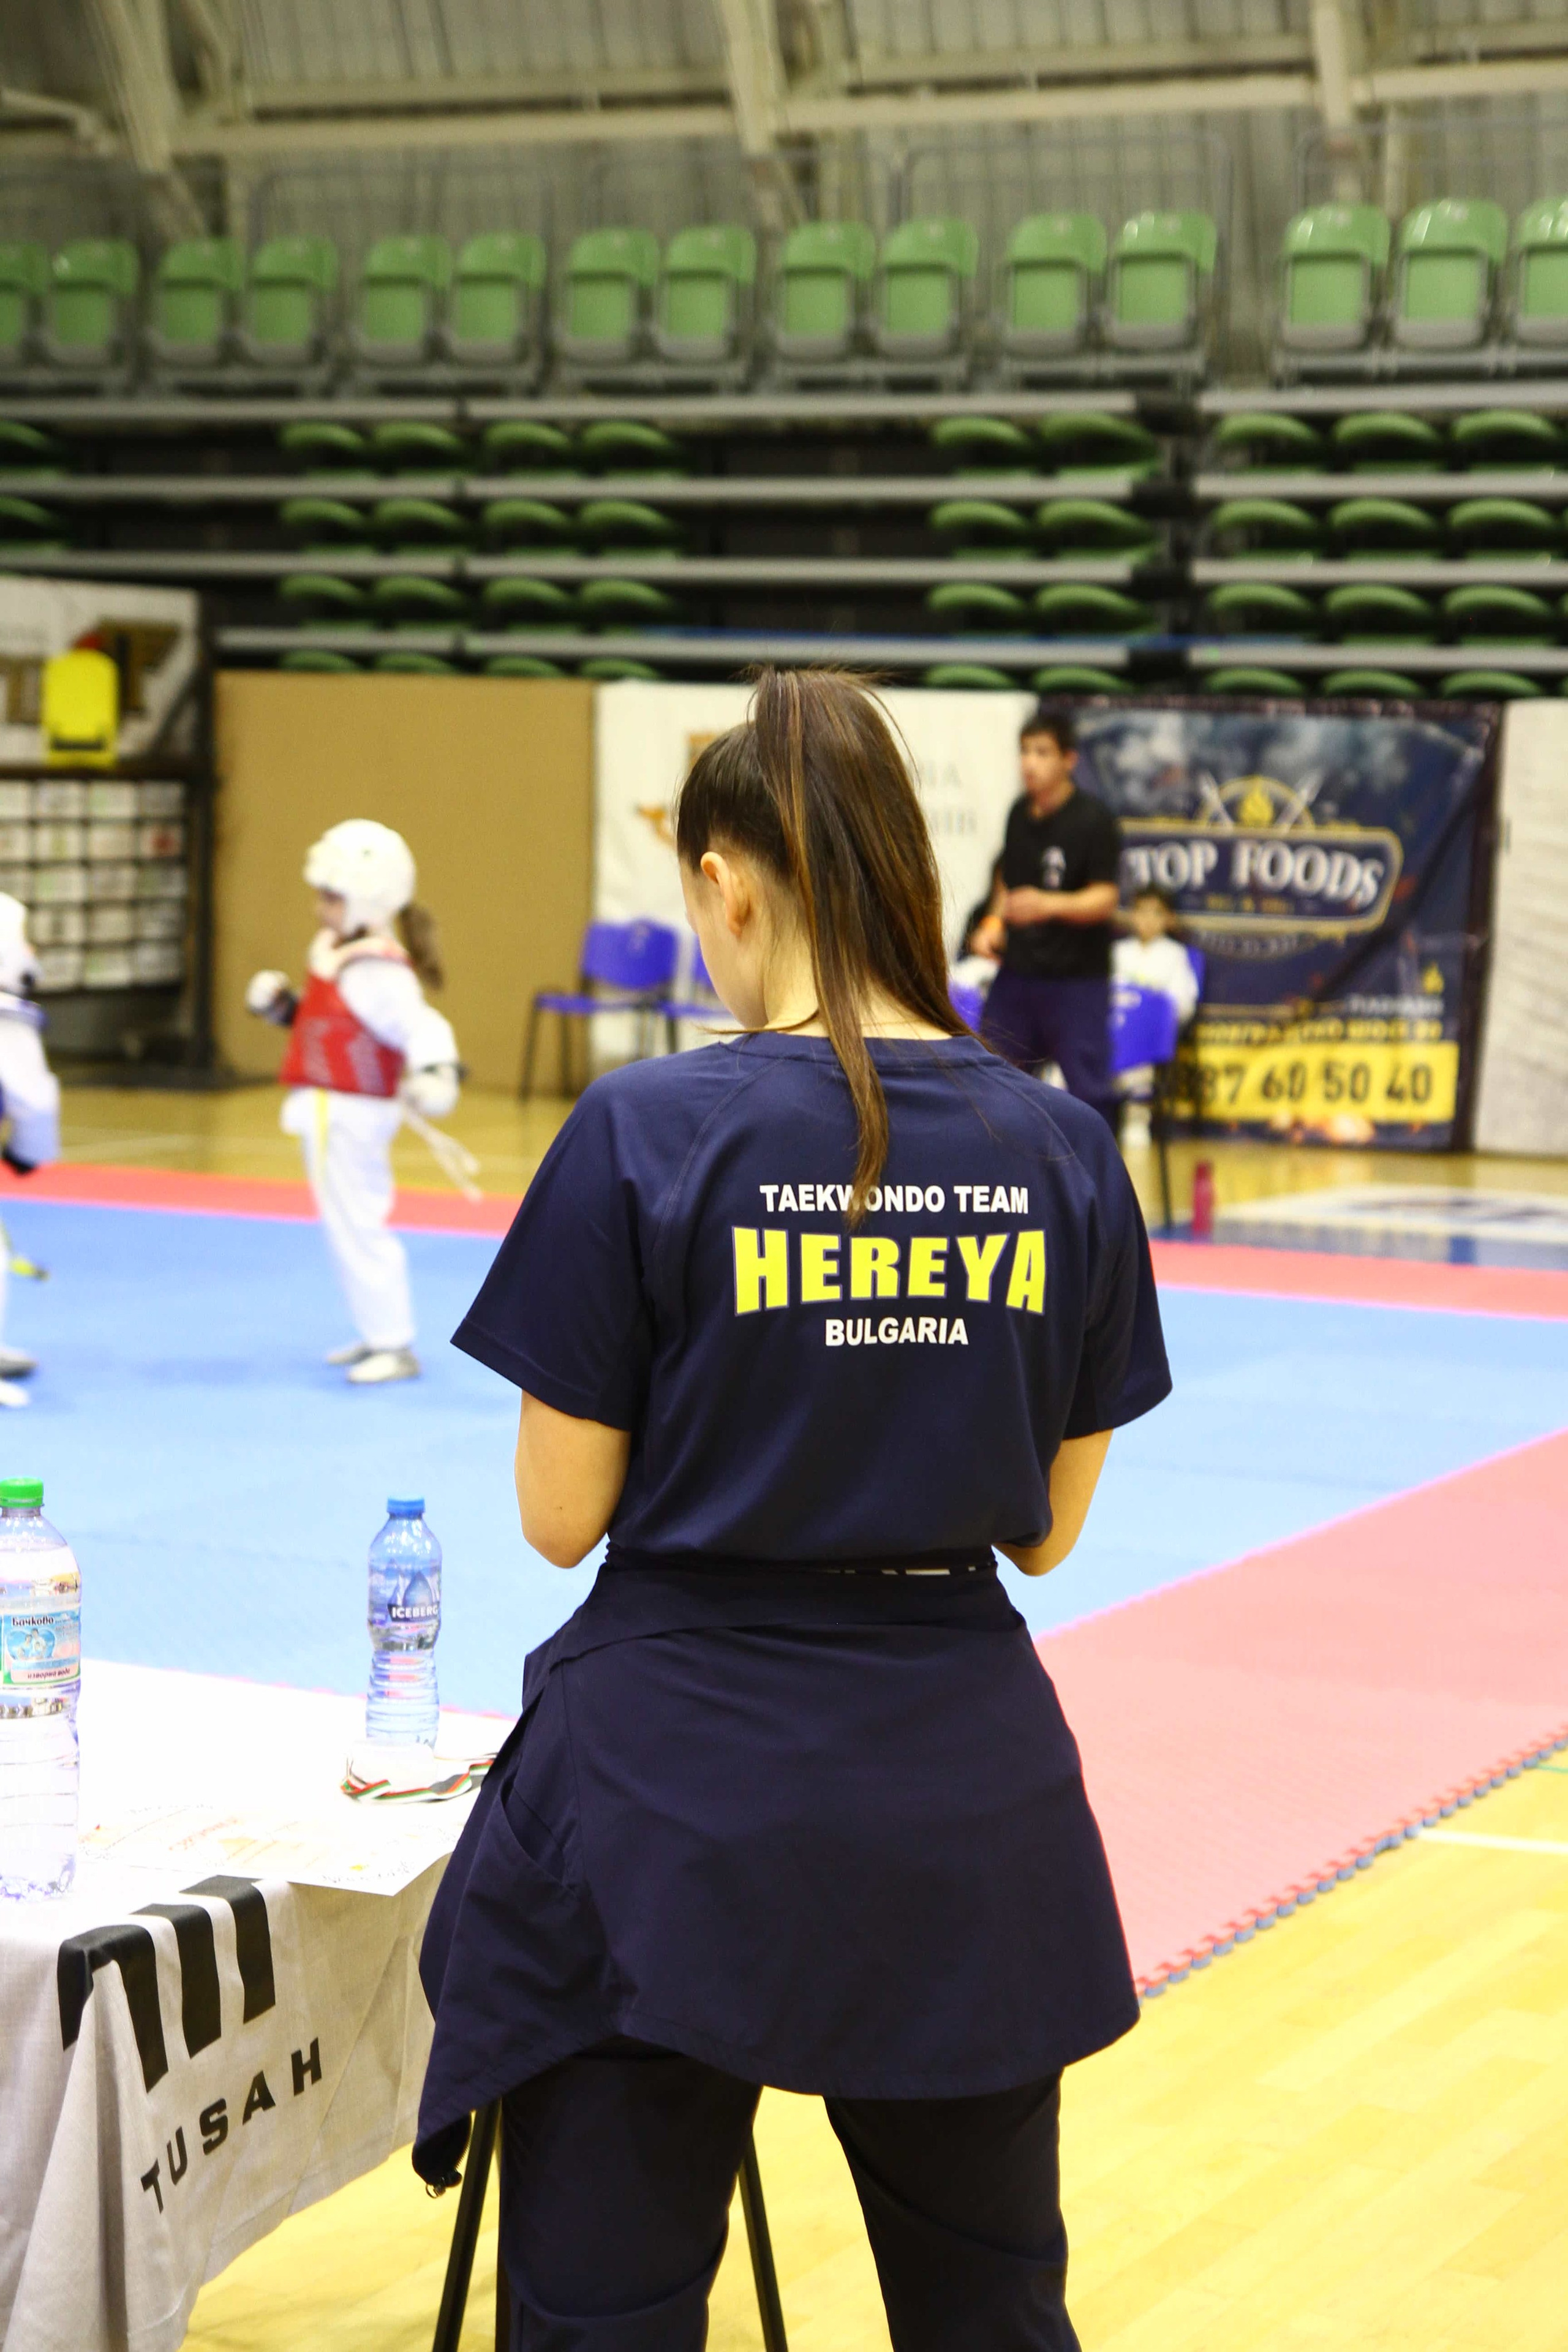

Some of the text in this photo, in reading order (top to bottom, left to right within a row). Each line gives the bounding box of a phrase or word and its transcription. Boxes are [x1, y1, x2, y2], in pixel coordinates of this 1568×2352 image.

[1126, 839, 1384, 909] TOP FOODS
[1261, 1059, 1308, 1102] 60
[1323, 1059, 1371, 1103] 50
[1387, 1060, 1433, 1103] 40
[954, 1185, 1029, 1214] TEAM
[732, 1226, 1045, 1316] HEREYA
[825, 1317, 968, 1347] BULGARIA
[391, 1605, 439, 1618] ICEBERG
[140, 2037, 322, 2215] TUSAH
